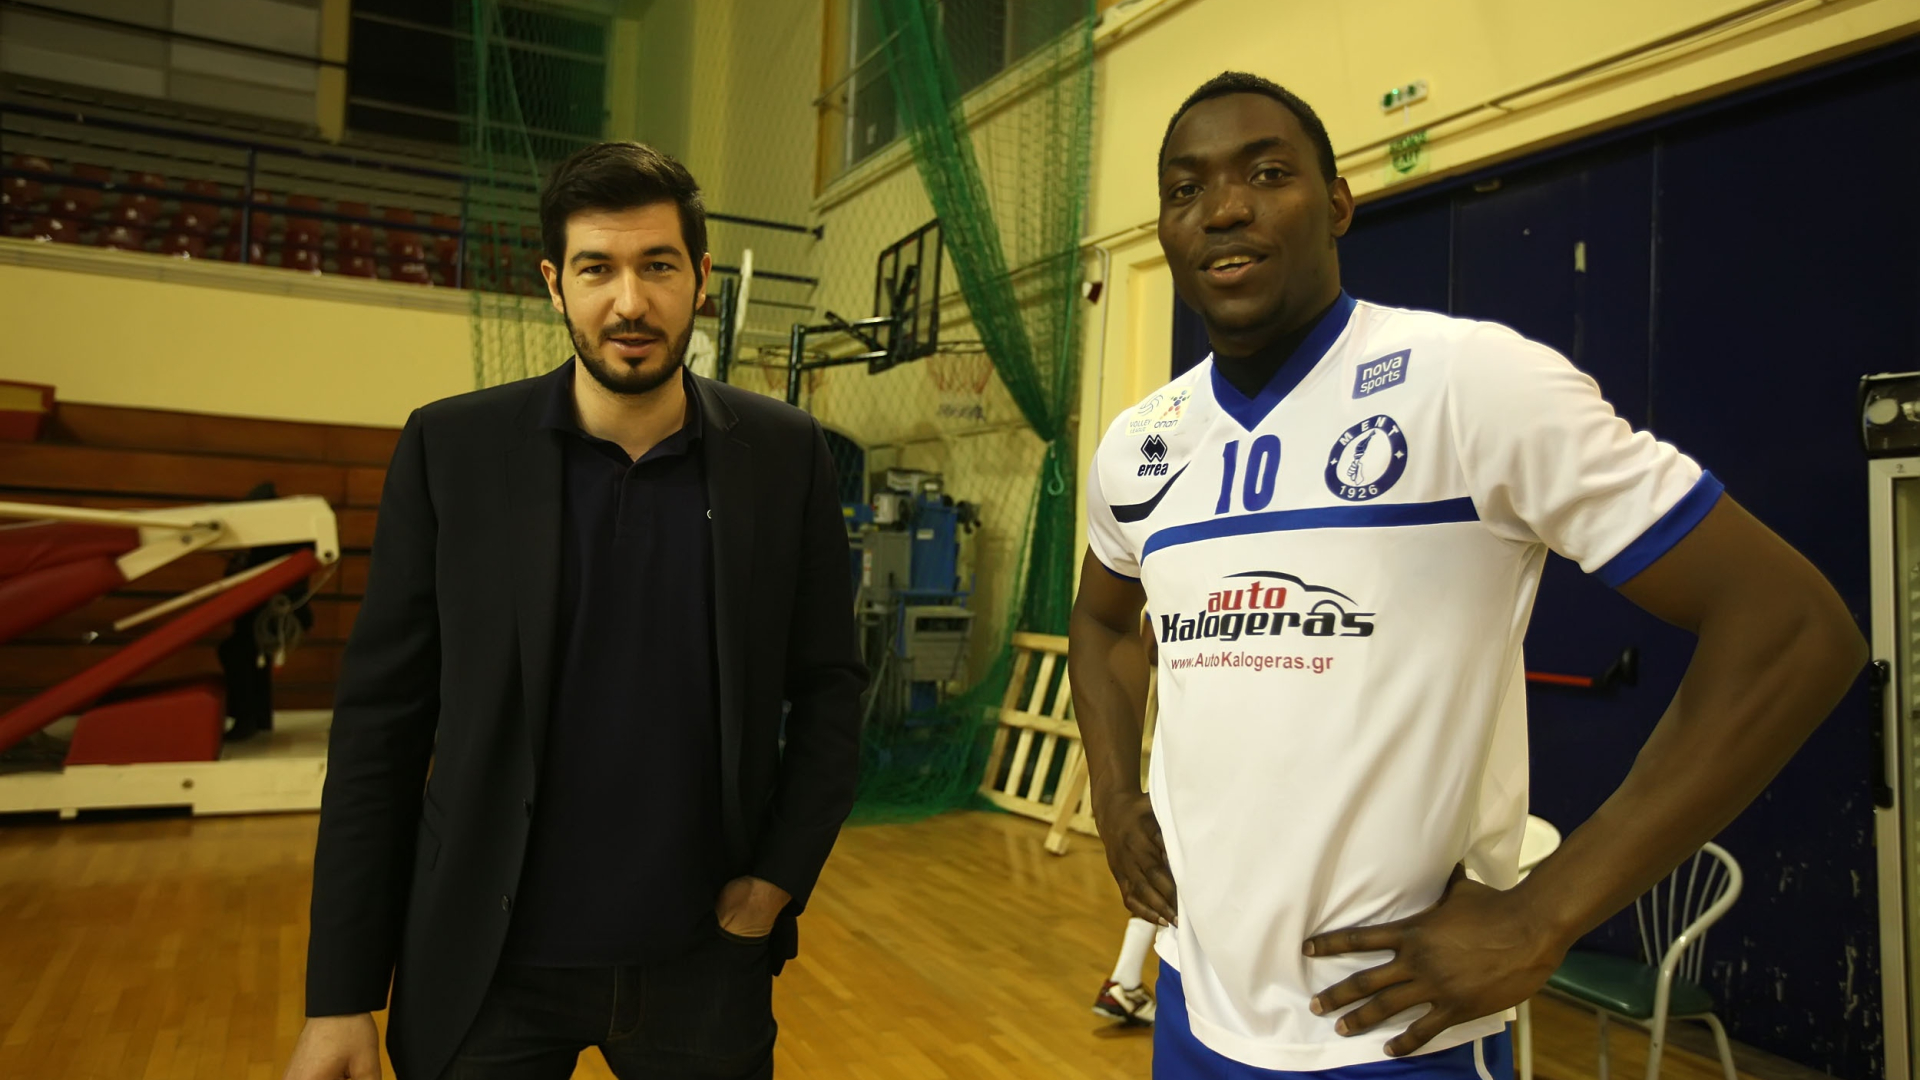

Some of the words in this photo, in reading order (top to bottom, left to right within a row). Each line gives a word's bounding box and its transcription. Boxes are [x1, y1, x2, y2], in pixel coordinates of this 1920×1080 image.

[1363, 356, 1402, 381] nova
[1360, 370, 1401, 394] sports
[1130, 419, 1152, 428] VOLLEY
[1339, 416, 1400, 446] MENT
[1215, 434, 1281, 515] 10
[1340, 484, 1378, 498] 1926
[1207, 581, 1287, 613] auto
[1160, 606, 1376, 643] Kalogeras
[1171, 651, 1333, 674] www.AutoKalogeras.gr
